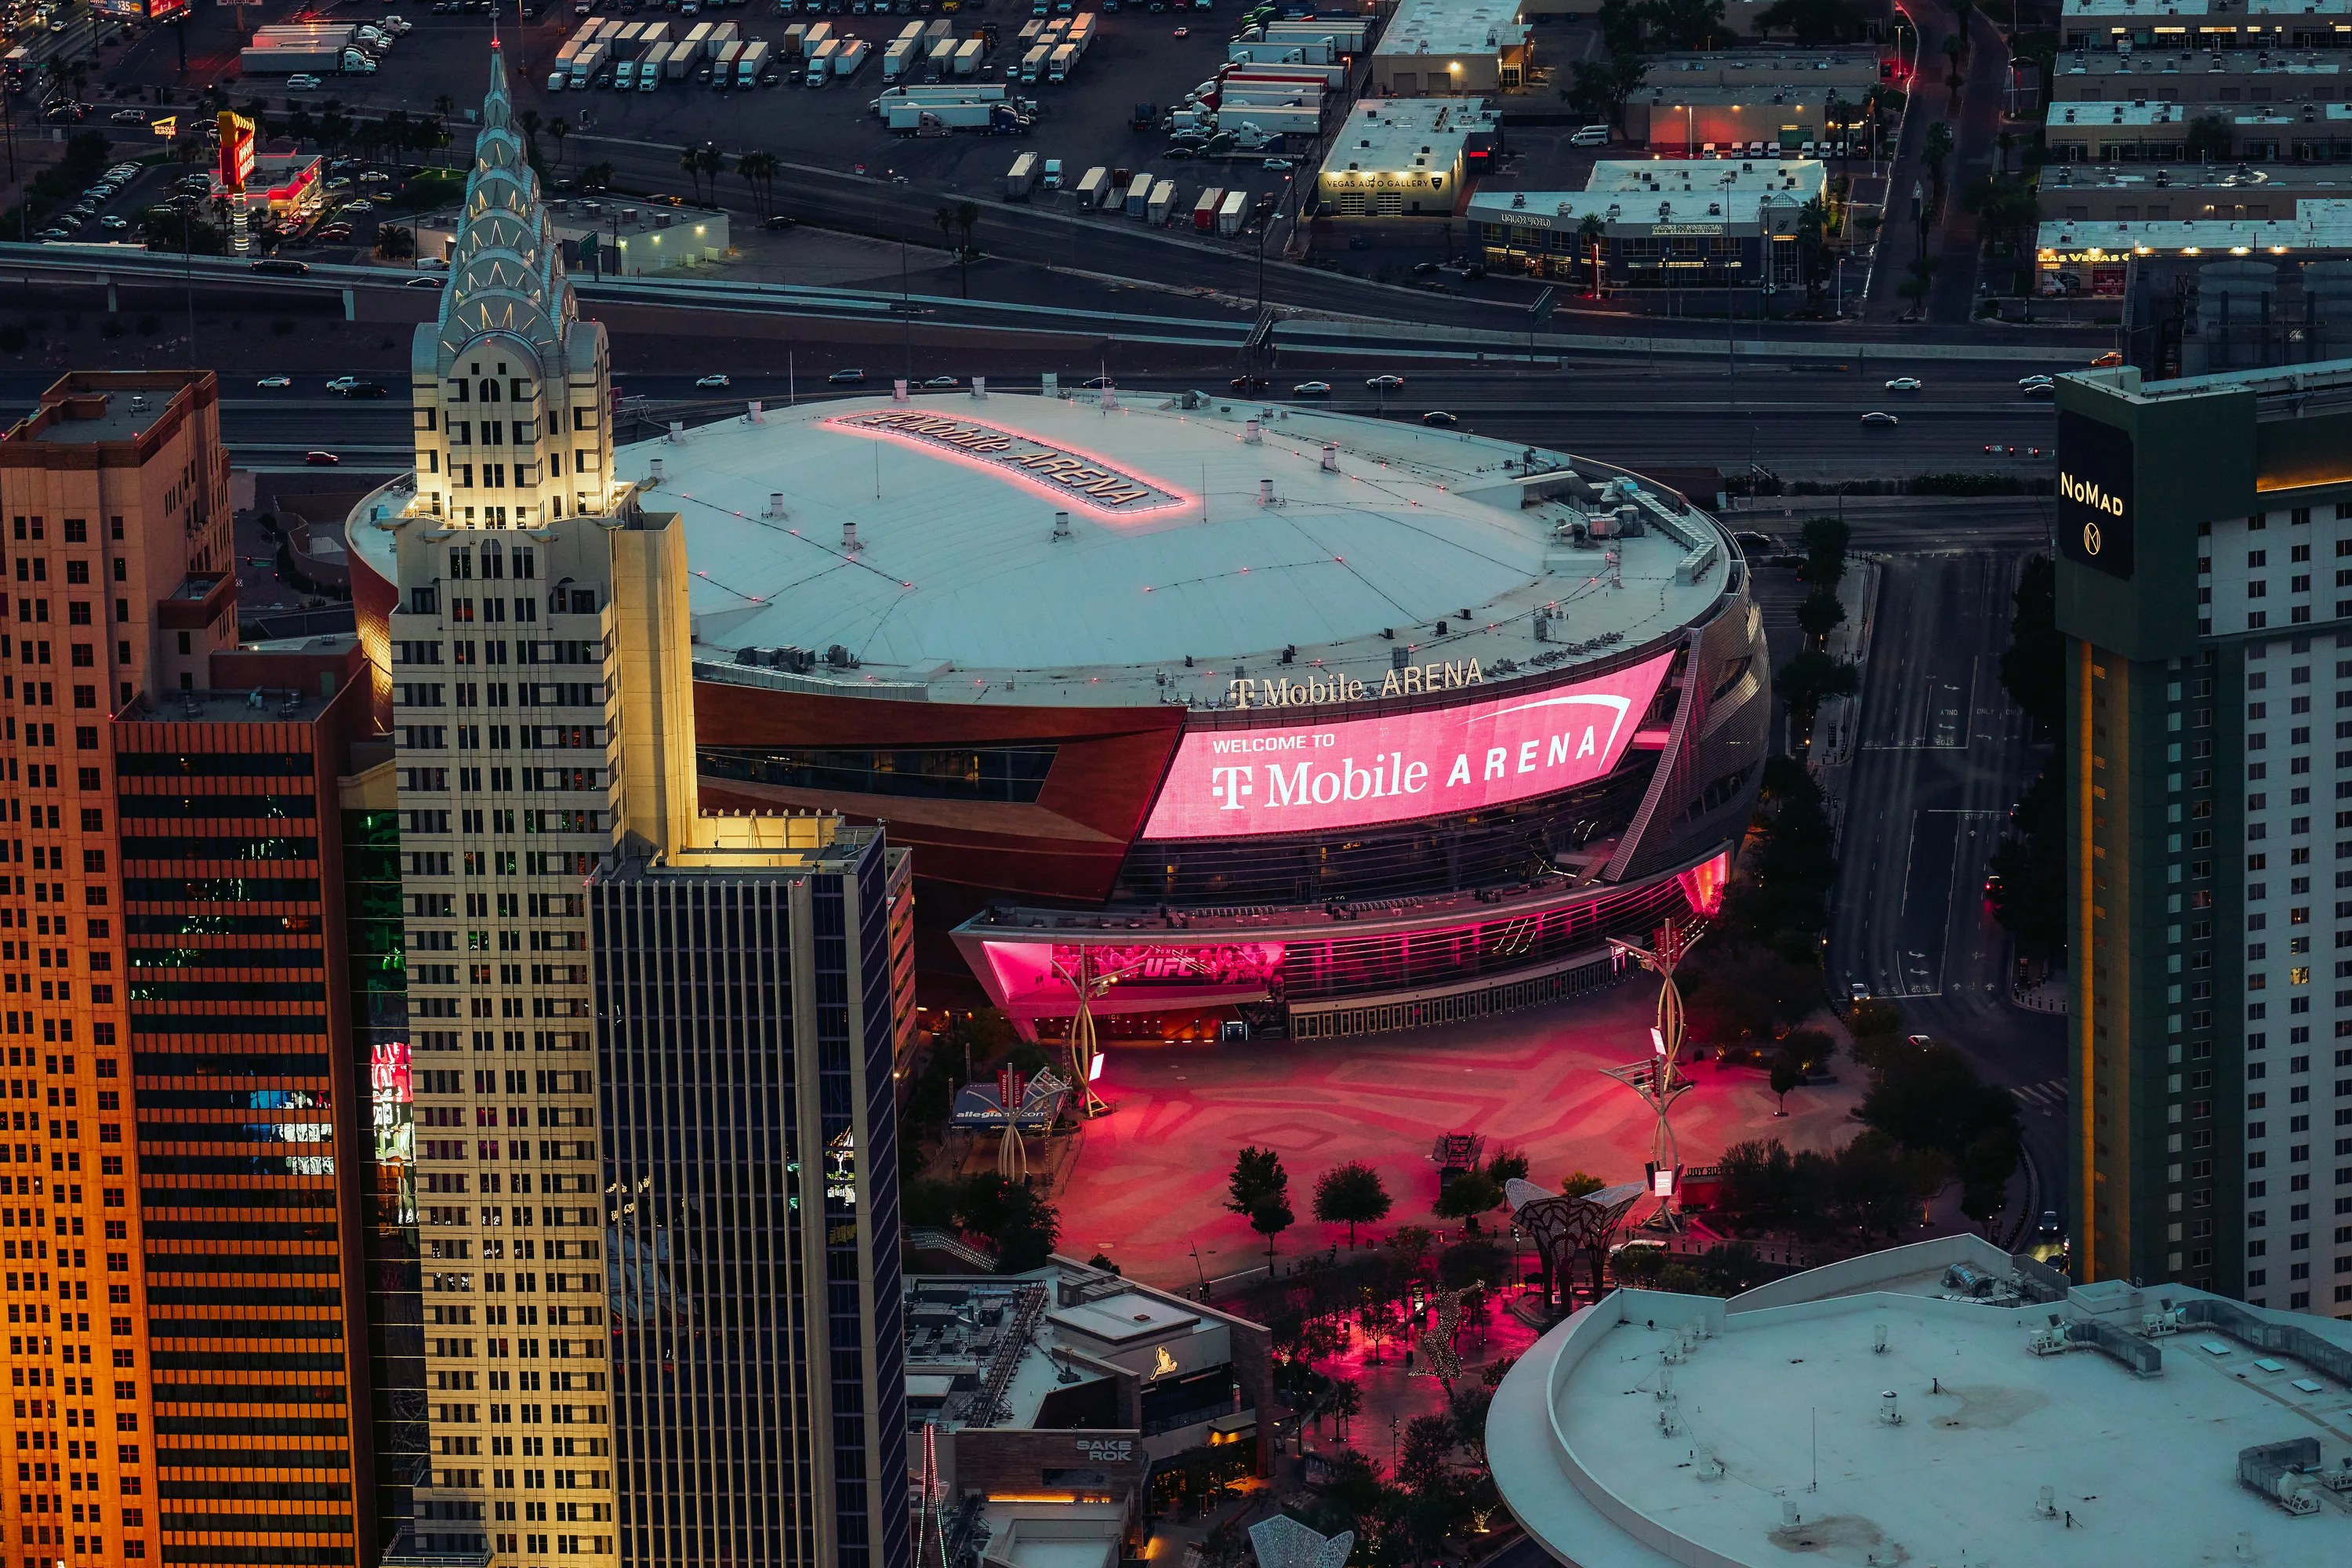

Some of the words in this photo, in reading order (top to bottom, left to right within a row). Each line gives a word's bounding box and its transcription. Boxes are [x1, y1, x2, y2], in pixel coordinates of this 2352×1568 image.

[117, 1, 130, 12] $35
[1501, 214, 1526, 224] LIQUOR
[1527, 217, 1551, 227] WORLD
[1002, 452, 1149, 506] ARENA
[1381, 657, 1484, 697] ARENA
[1213, 735, 1307, 753] WELCOME
[1312, 733, 1335, 748] TO
[1446, 725, 1595, 788] ARENA
[1145, 957, 1196, 977] UFC
[1076, 1440, 1132, 1450] SAKE
[1089, 1450, 1132, 1461] ROK
